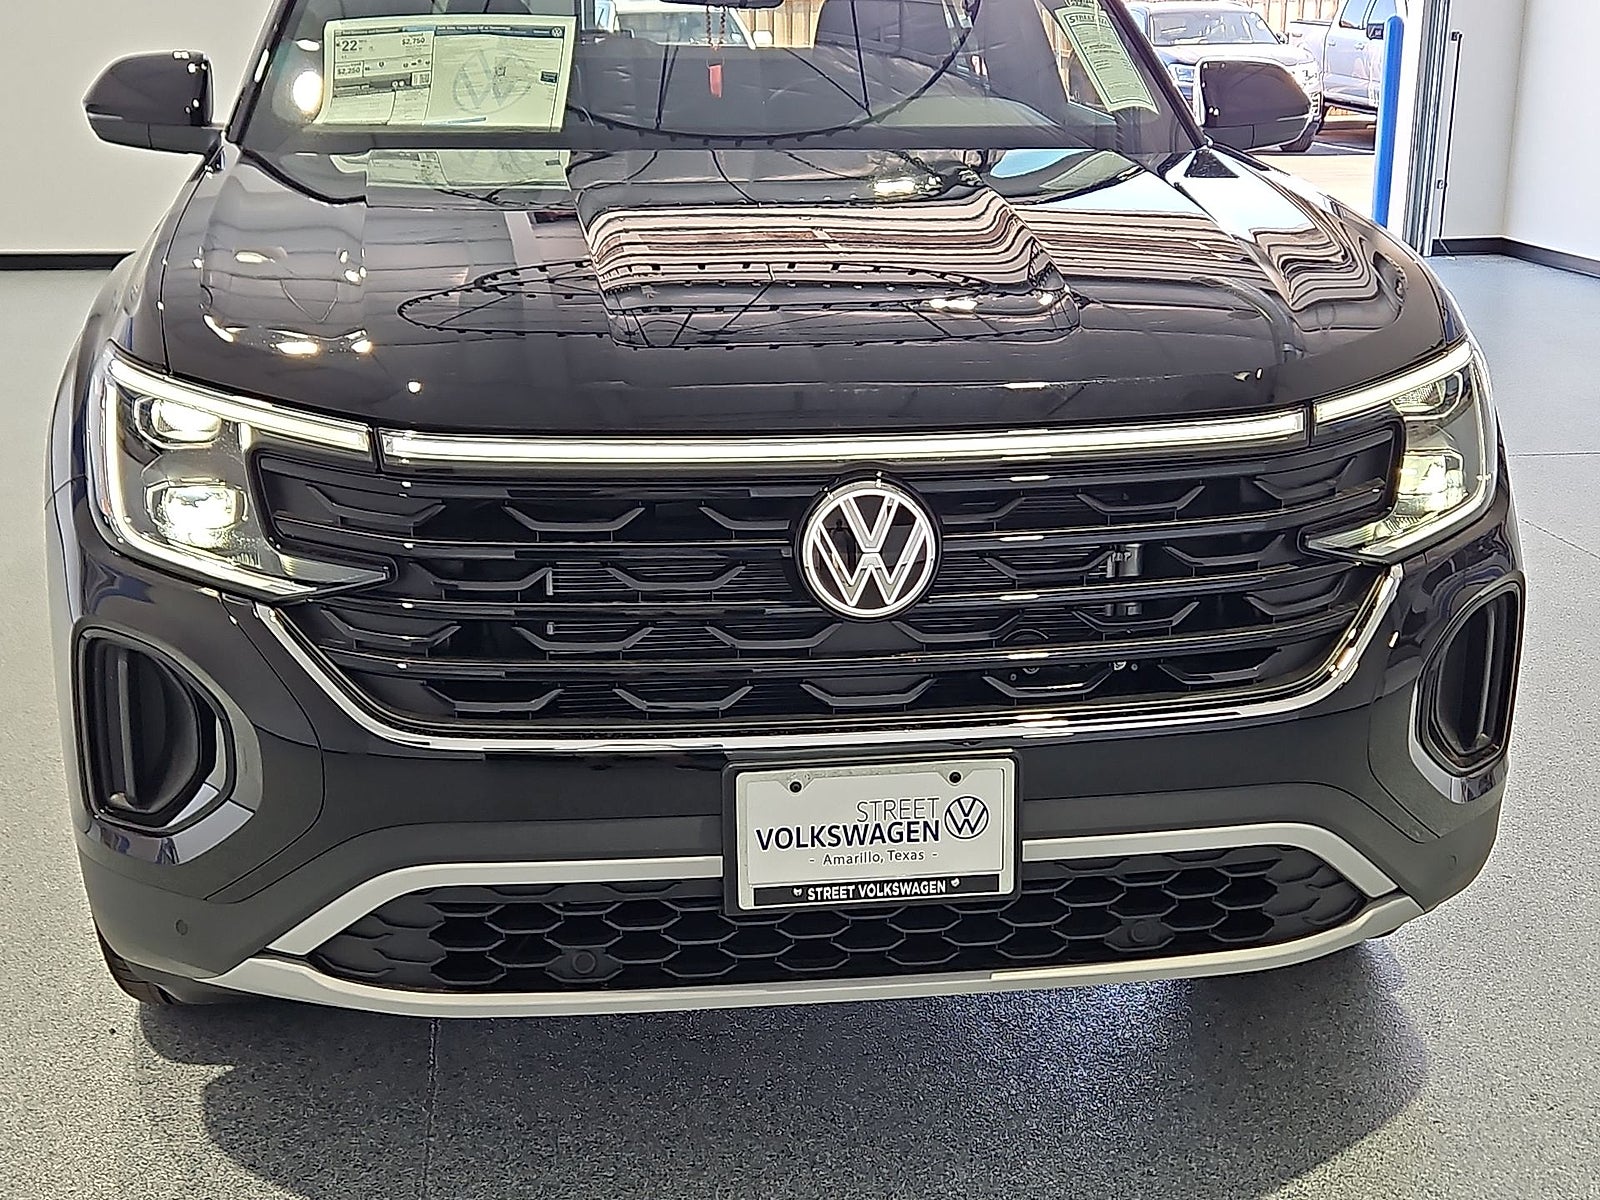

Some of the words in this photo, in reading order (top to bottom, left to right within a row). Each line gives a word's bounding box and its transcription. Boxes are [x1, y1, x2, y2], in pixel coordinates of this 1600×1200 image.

[341, 39, 358, 52] 22
[856, 797, 940, 823] STREET
[756, 820, 940, 850] VOLKSWAGEN
[822, 851, 884, 866] Amarillo,
[887, 849, 924, 862] Texas
[807, 885, 855, 901] STREET
[858, 880, 946, 897] VOLKSWAGEN
